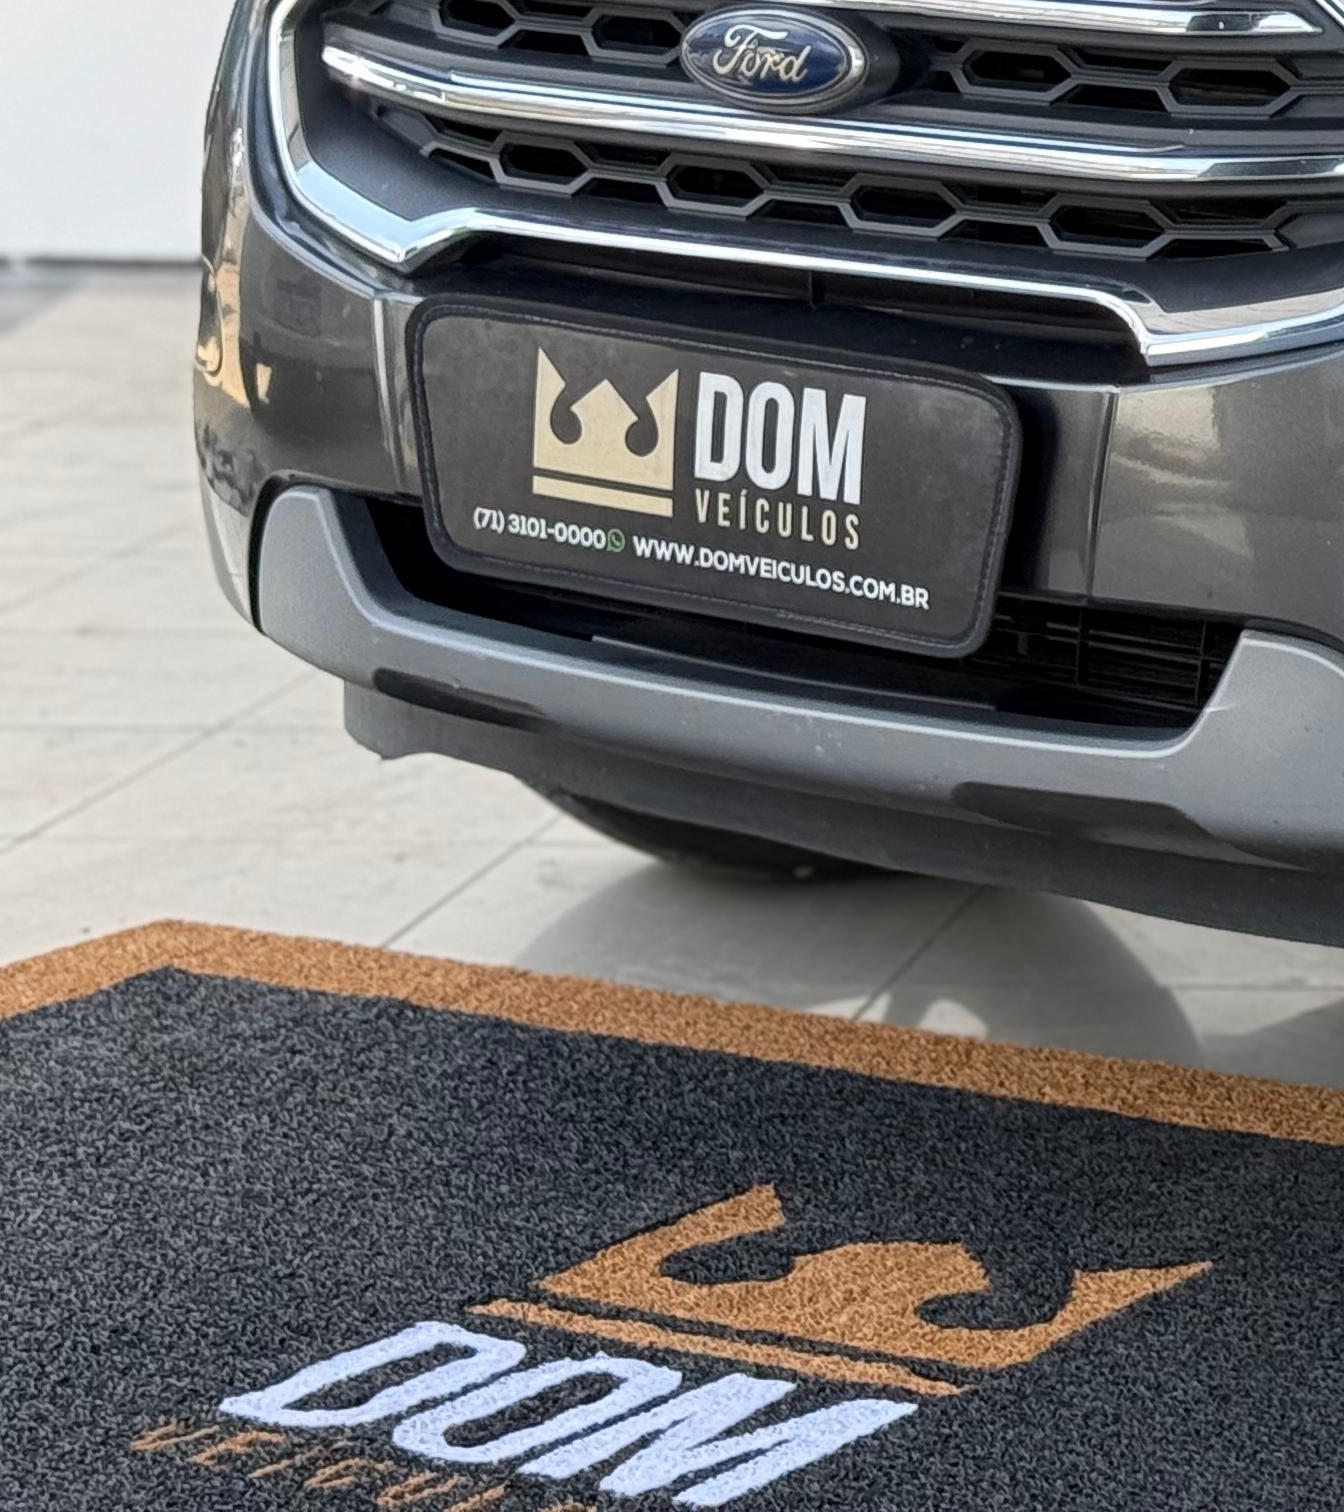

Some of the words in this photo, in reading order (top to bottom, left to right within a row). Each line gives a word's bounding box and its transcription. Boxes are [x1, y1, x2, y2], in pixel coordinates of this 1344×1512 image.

[713, 24, 812, 83] Ford
[694, 371, 867, 506] DOM
[473, 506, 505, 534] (71)
[508, 513, 606, 550] 3101-0000
[632, 535, 930, 610] WWW.DOMVEICULOS.COM.BR
[695, 488, 860, 550] VEÍCULOS
[217, 1320, 918, 1508] DOM
